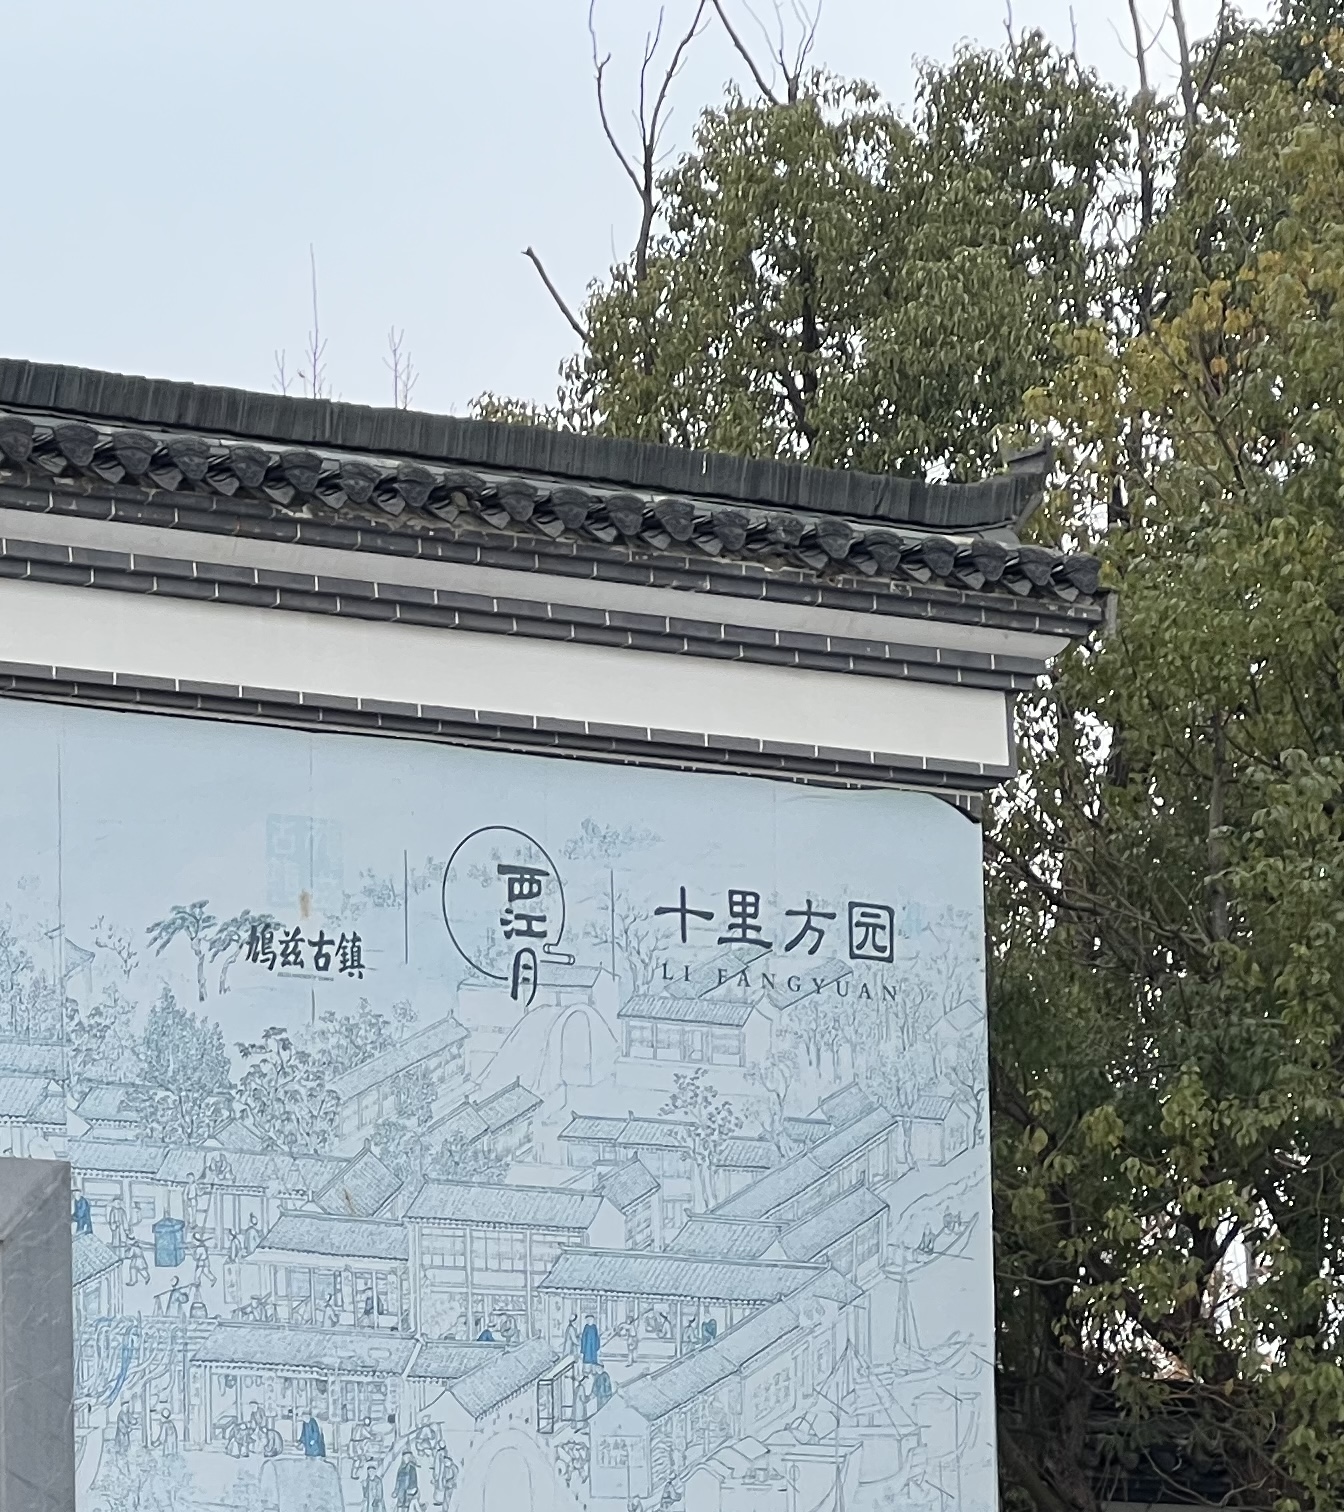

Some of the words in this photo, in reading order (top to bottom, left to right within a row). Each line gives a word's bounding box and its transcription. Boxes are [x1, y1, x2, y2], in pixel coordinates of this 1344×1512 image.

[654, 885, 896, 963] 十里方园
[661, 962, 691, 982] LI
[717, 967, 898, 1001] FANGYUAN
